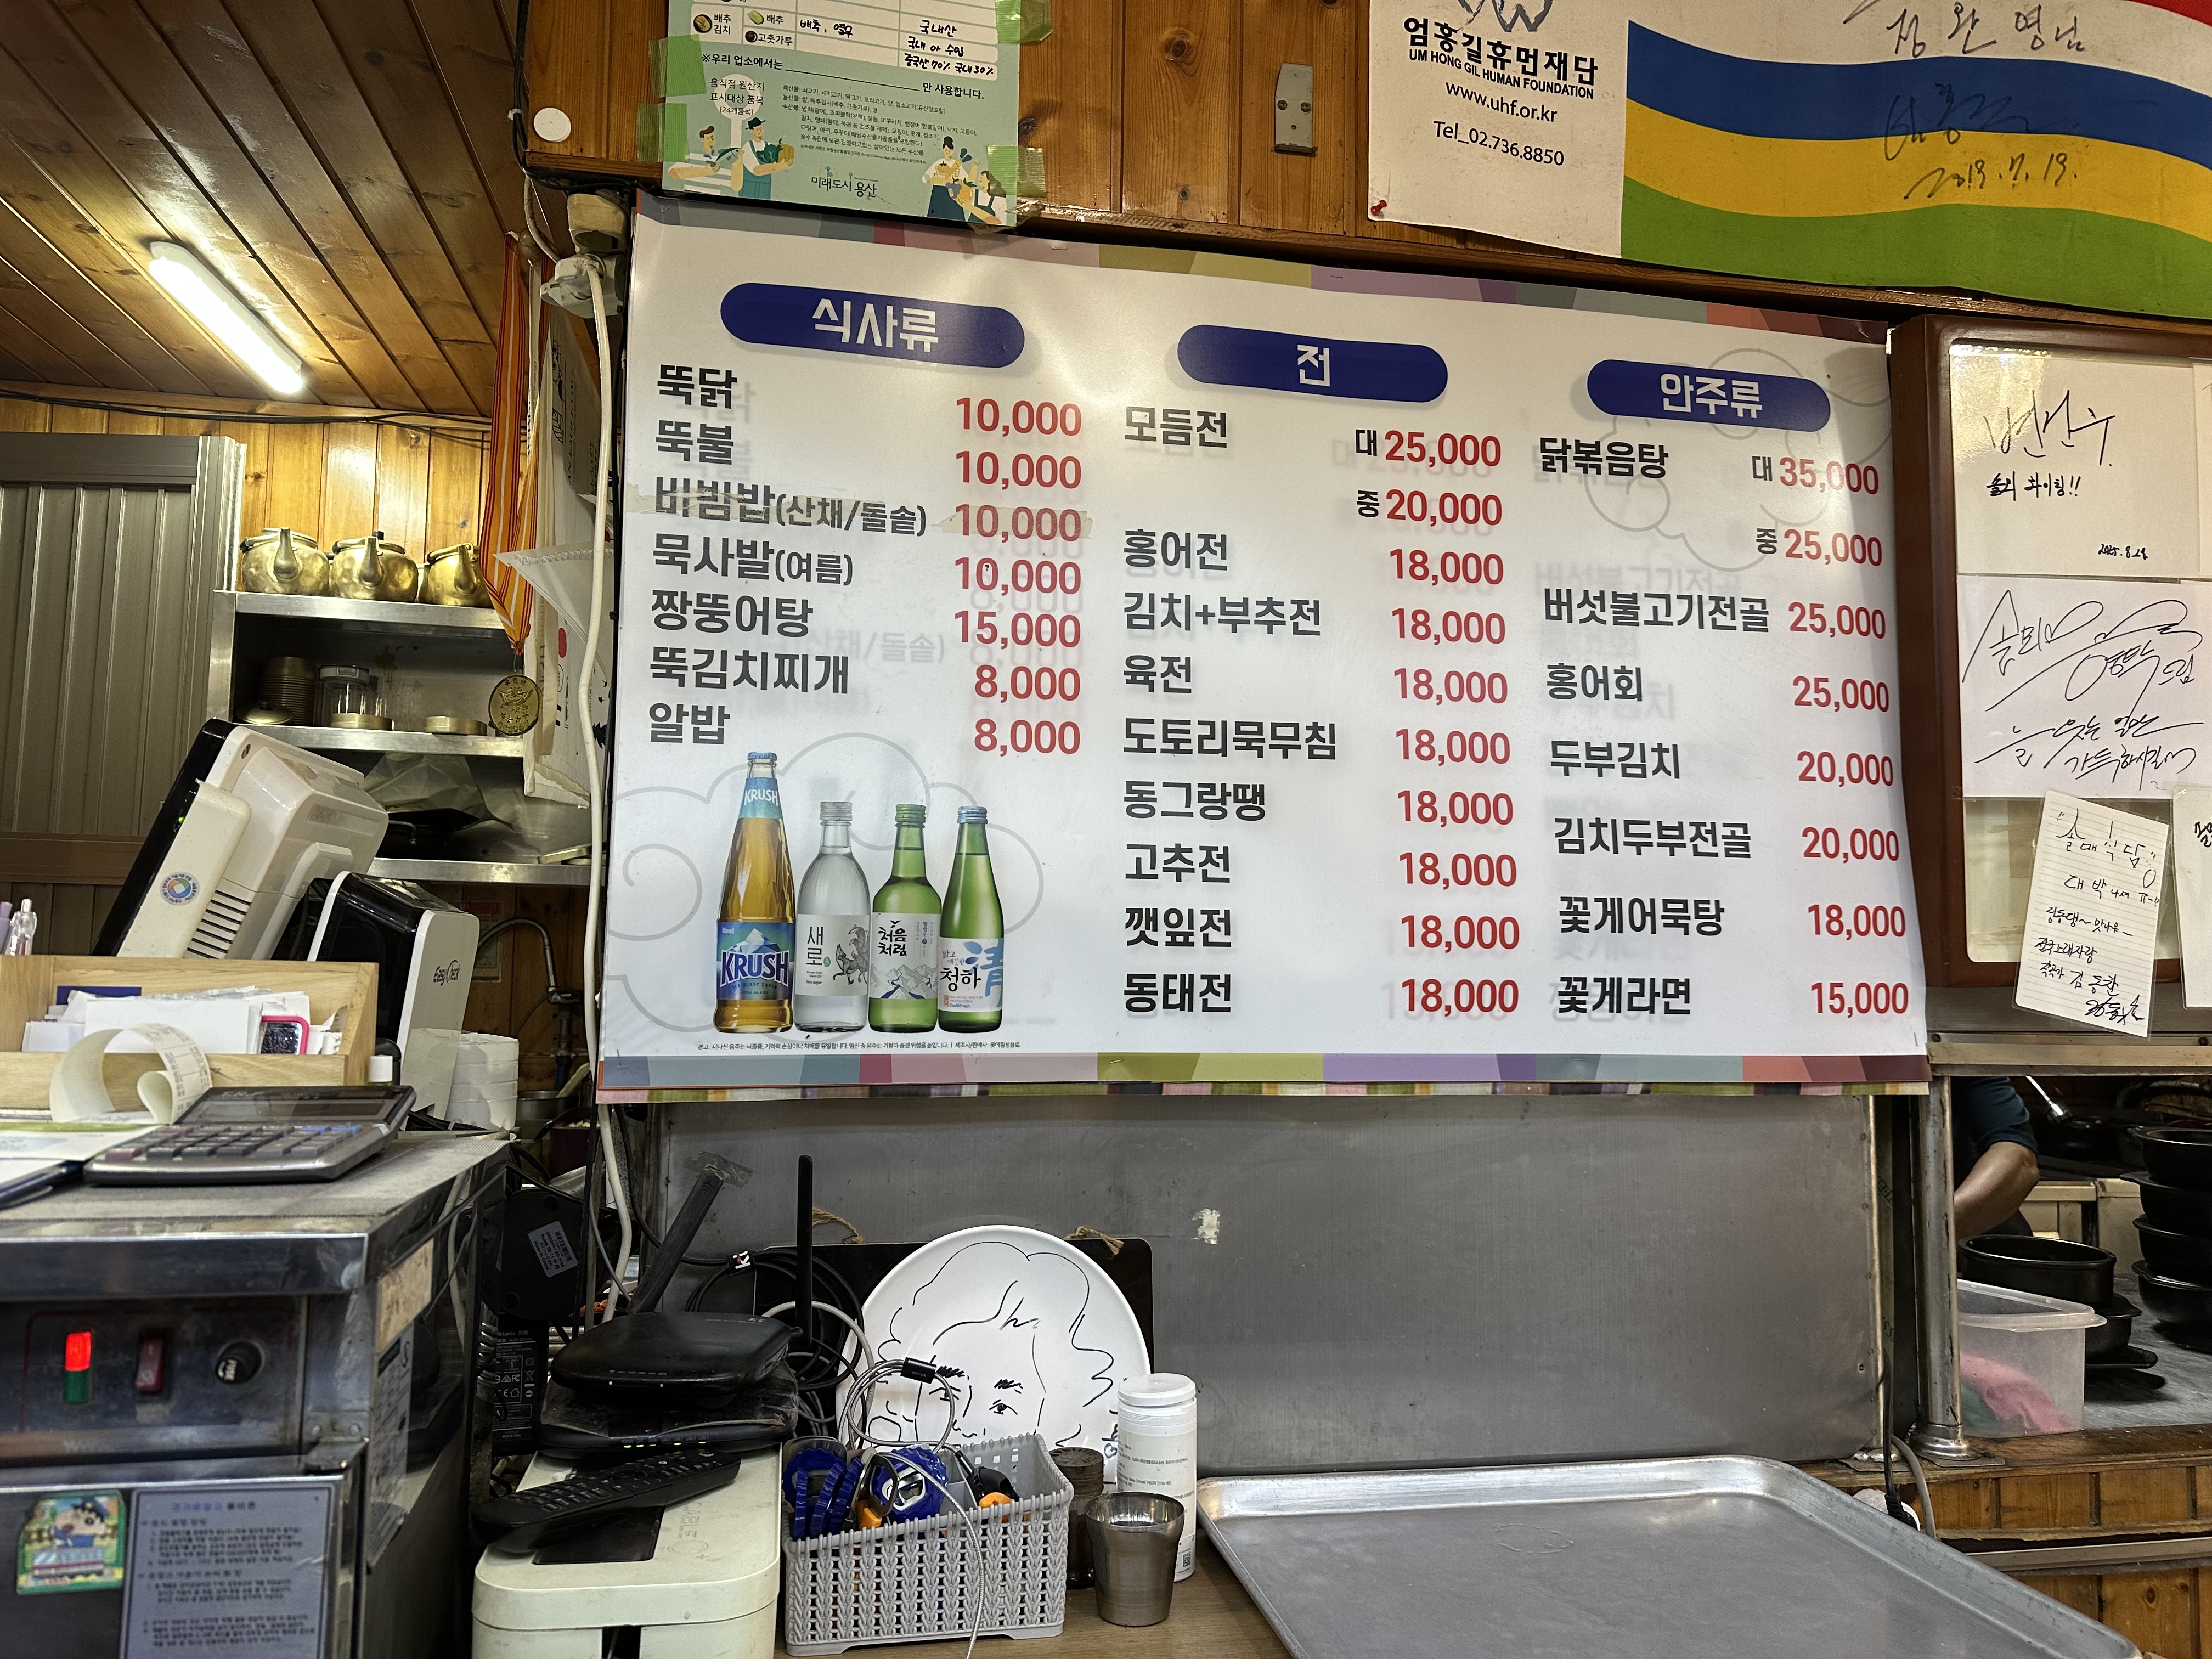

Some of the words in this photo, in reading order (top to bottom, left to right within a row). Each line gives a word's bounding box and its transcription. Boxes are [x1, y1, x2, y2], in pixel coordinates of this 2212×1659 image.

[714, 13, 731, 24] 배추
[714, 25, 731, 35] 김치
[758, 33, 793, 46] 고춧가루
[766, 14, 784, 25] 배추
[919, 20, 957, 38] 국내산
[904, 53, 930, 70] 중국산
[907, 36, 926, 50] 국내
[1404, 17, 1598, 86] 엄홍길휴먼재단
[709, 78, 736, 89] 음식점
[738, 79, 765, 92] 원산지
[733, 55, 783, 70] 업소에서는
[923, 82, 933, 93] 만
[935, 84, 985, 100] 사용합니다.
[1409, 48, 1428, 61] UM
[1430, 50, 1462, 70] HONG
[1464, 62, 1481, 78] GIL
[1482, 68, 1521, 88] HUMAN
[1523, 78, 1594, 100] FOUNDATION
[709, 93, 744, 104] 표시대상
[746, 95, 765, 105] 품목
[719, 106, 754, 116] (24개품목)
[1446, 82, 1558, 122] www.uhf.or.kr
[1433, 121, 1565, 166] Tel_02.736.8850
[811, 177, 852, 191] 미래도시
[854, 182, 877, 198] 용산
[812, 298, 939, 353] 식사류
[1296, 343, 1331, 387] 전
[657, 364, 737, 409] 뚝닭
[957, 398, 1081, 436] 10,000
[1660, 373, 1763, 419] 안주류
[656, 420, 733, 465] 뚝불
[957, 451, 1081, 489] 10,000
[1125, 408, 1227, 448] 모듬전
[1356, 430, 1377, 456] 대
[1385, 430, 1500, 467] 25,000
[1541, 438, 1668, 478] 닭볶음탕
[1752, 456, 1772, 481] 대
[1779, 457, 1878, 495] 35,000
[956, 504, 1080, 542] 10,000
[1357, 490, 1379, 517] 중
[1386, 489, 1502, 526] 20,000
[653, 533, 852, 585] 묵사발(여름)
[956, 557, 1080, 595] 10,000
[1124, 529, 1227, 571] 홍어전
[1390, 549, 1503, 585] 18,000
[1756, 528, 1777, 554] 중
[1784, 528, 1883, 567] 25,000
[652, 590, 813, 637] 짱뚱어탕
[956, 611, 1080, 648] 15,000
[1124, 592, 1320, 635] 김치+부추전
[1392, 608, 1505, 644] 18,000
[1545, 589, 1768, 632] 버섯불고기전골
[1789, 602, 1884, 638] 25,000
[651, 647, 848, 693] 뚝김치찌개
[975, 665, 1080, 702] 8,000
[1124, 656, 1191, 693] 육전
[1395, 669, 1507, 704] 18,000
[1547, 663, 1642, 701] 홍어회
[1793, 676, 1888, 711] 25,000
[650, 703, 730, 744] 알밥
[975, 719, 1080, 755] 8,000
[1124, 718, 1335, 759] 도토리묵무침
[1397, 729, 1509, 765] 18,000
[1551, 741, 1679, 779] 두부김치
[1798, 751, 1892, 786] 20,000
[744, 788, 778, 808] KRUSH
[1124, 781, 1265, 821] 동그랑땡
[1398, 791, 1513, 827] 18,000
[1555, 817, 1751, 858] 김치두부전골
[1803, 827, 1898, 861] 20,000
[1126, 844, 1230, 883] 고추전
[1400, 853, 1516, 889] 18,000
[878, 926, 907, 943] 처음
[1125, 908, 1231, 947] 깻잎전
[1402, 915, 1519, 952] 18,000
[1560, 896, 1724, 936] 꽃게어묵탕
[1809, 904, 1905, 939] 18,000
[720, 950, 789, 987] KRUSH
[806, 927, 823, 966] 새로
[878, 942, 907, 956] 처럼
[939, 967, 982, 992] 청하
[1124, 974, 1231, 1012] 동태전
[1402, 979, 1518, 1016] 18,000
[1558, 977, 1690, 1014] 꽃게라면
[1812, 983, 1908, 1017] 15,000
